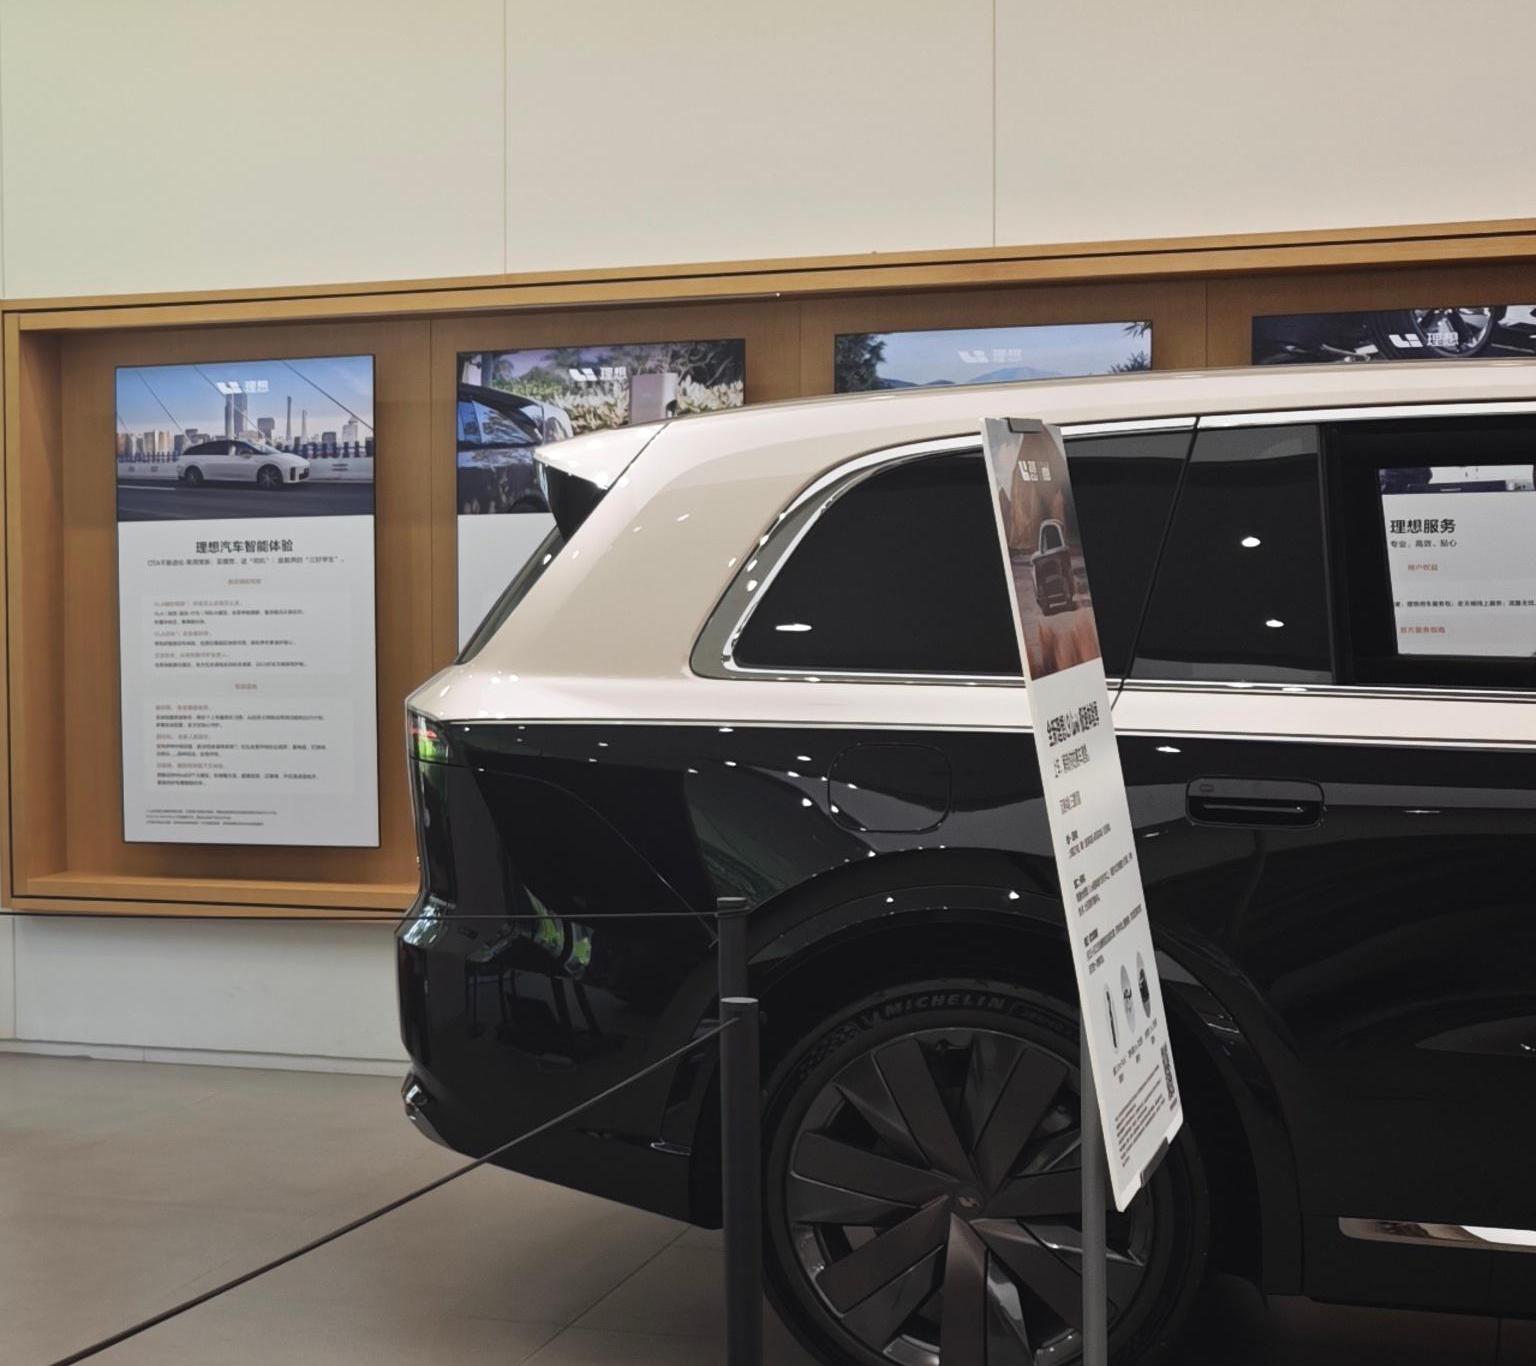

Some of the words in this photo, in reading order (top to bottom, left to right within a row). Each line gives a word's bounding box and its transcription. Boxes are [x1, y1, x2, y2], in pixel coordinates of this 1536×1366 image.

[600, 366, 628, 381] 理想
[1390, 518, 1457, 535] 理想服务
[195, 539, 294, 554] 理想汽车智能体验
[885, 993, 1006, 1019] MICHELIN
